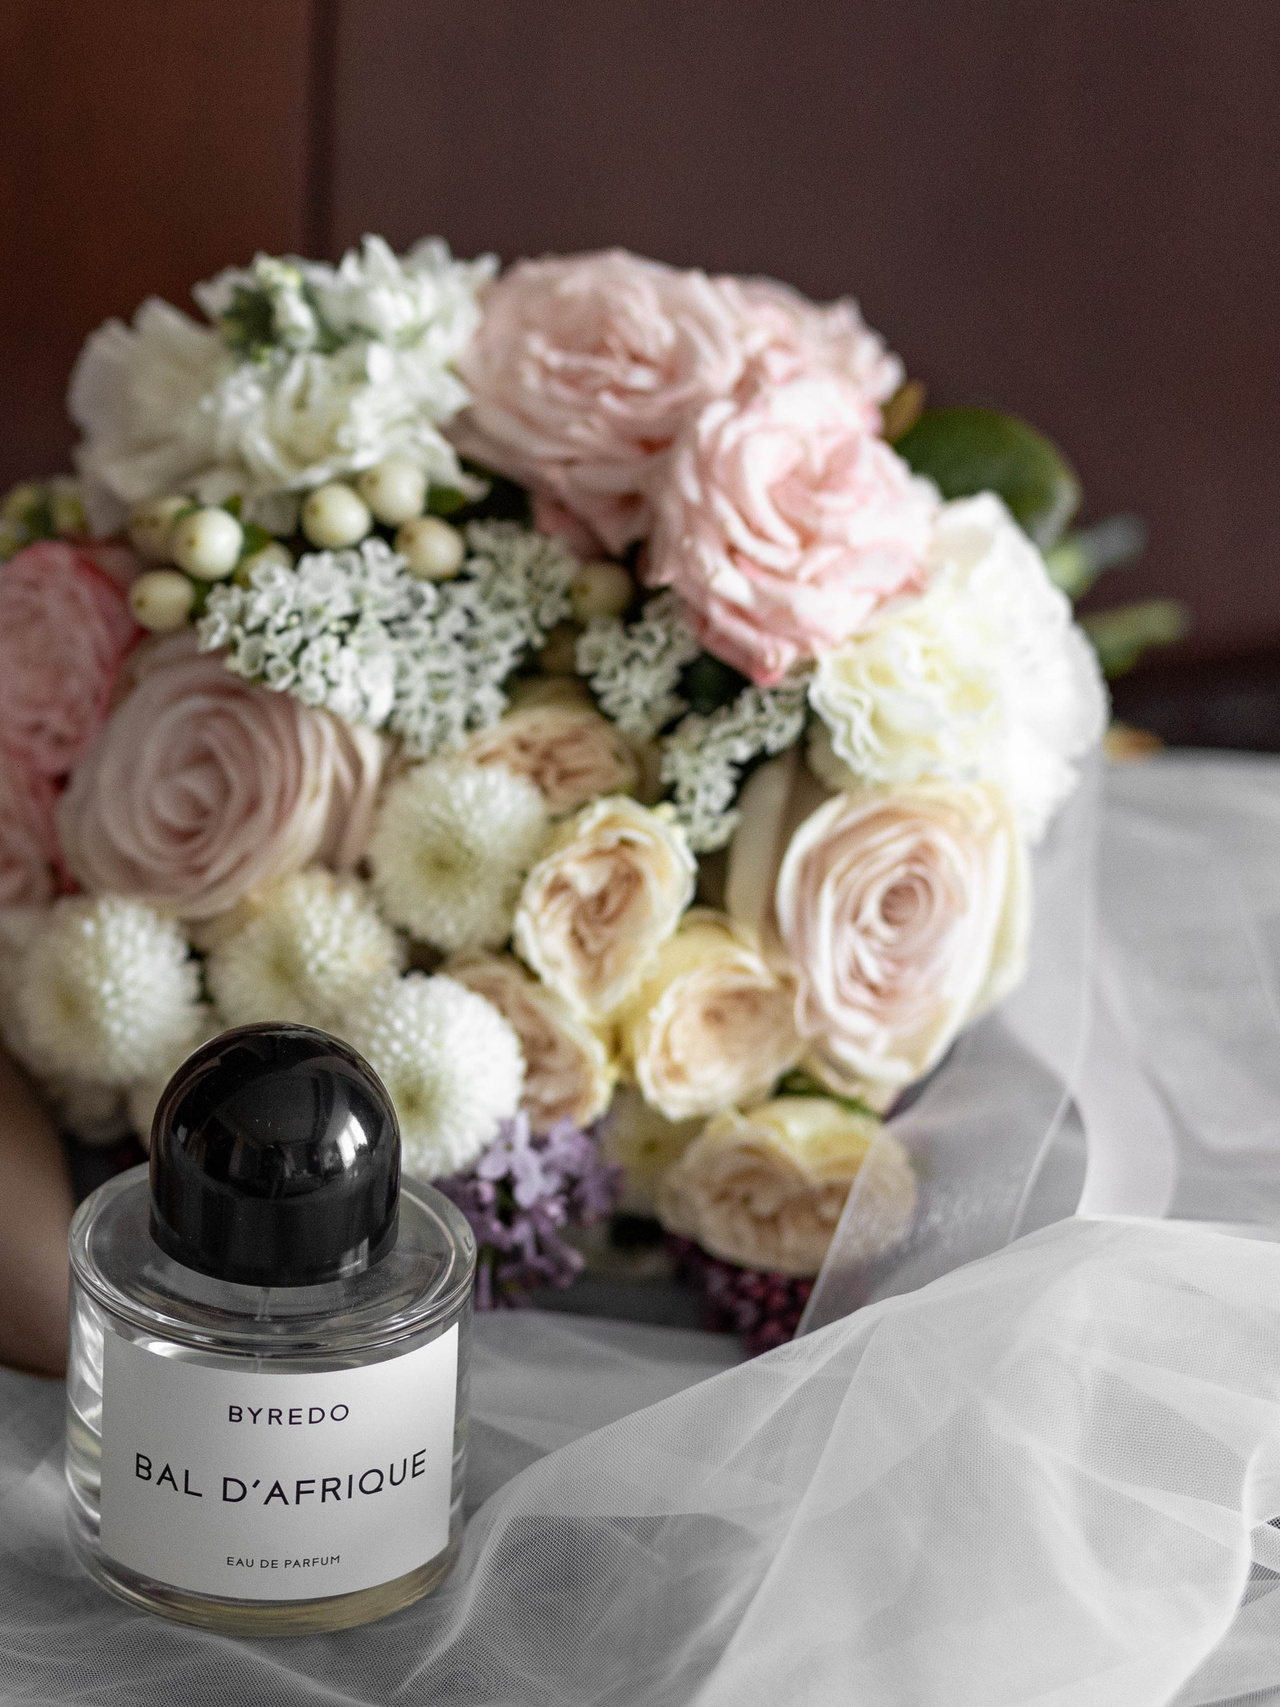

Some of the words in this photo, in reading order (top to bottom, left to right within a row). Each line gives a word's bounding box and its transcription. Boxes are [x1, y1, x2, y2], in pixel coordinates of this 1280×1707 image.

[228, 1403, 350, 1426] BYREDO
[135, 1452, 203, 1498] BAL
[222, 1448, 427, 1506] D'AFRIQUE
[226, 1556, 255, 1568] EAU
[259, 1558, 279, 1569] DE
[284, 1554, 341, 1569] PARFUM
